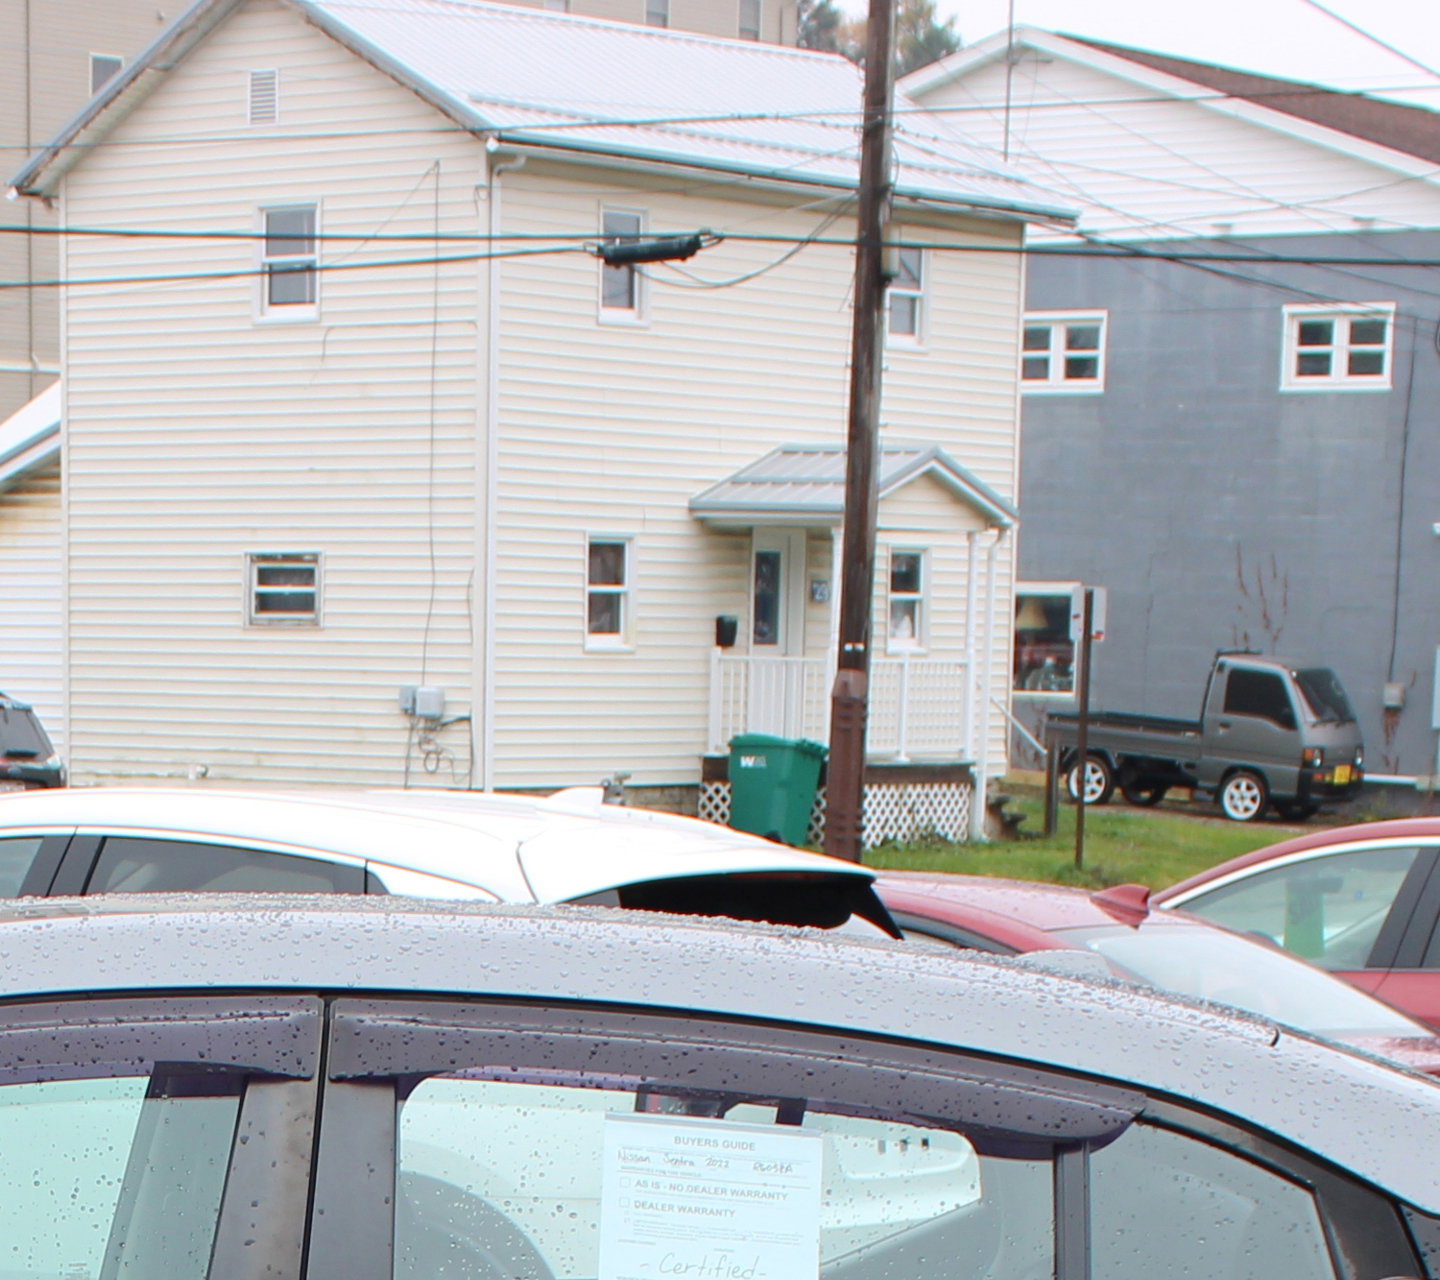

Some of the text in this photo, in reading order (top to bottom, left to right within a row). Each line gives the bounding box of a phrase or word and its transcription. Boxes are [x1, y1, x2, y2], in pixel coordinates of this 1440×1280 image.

[674, 1135, 756, 1151] BUYERS GUIDE
[634, 1179, 649, 1190] AS
[650, 1180, 661, 1190] IS
[669, 1183, 685, 1193] NO
[687, 1184, 728, 1197] DEALER
[729, 1188, 789, 1201] WARRANTY
[633, 1200, 675, 1213] DEALER
[677, 1204, 736, 1218] WARRANTY
